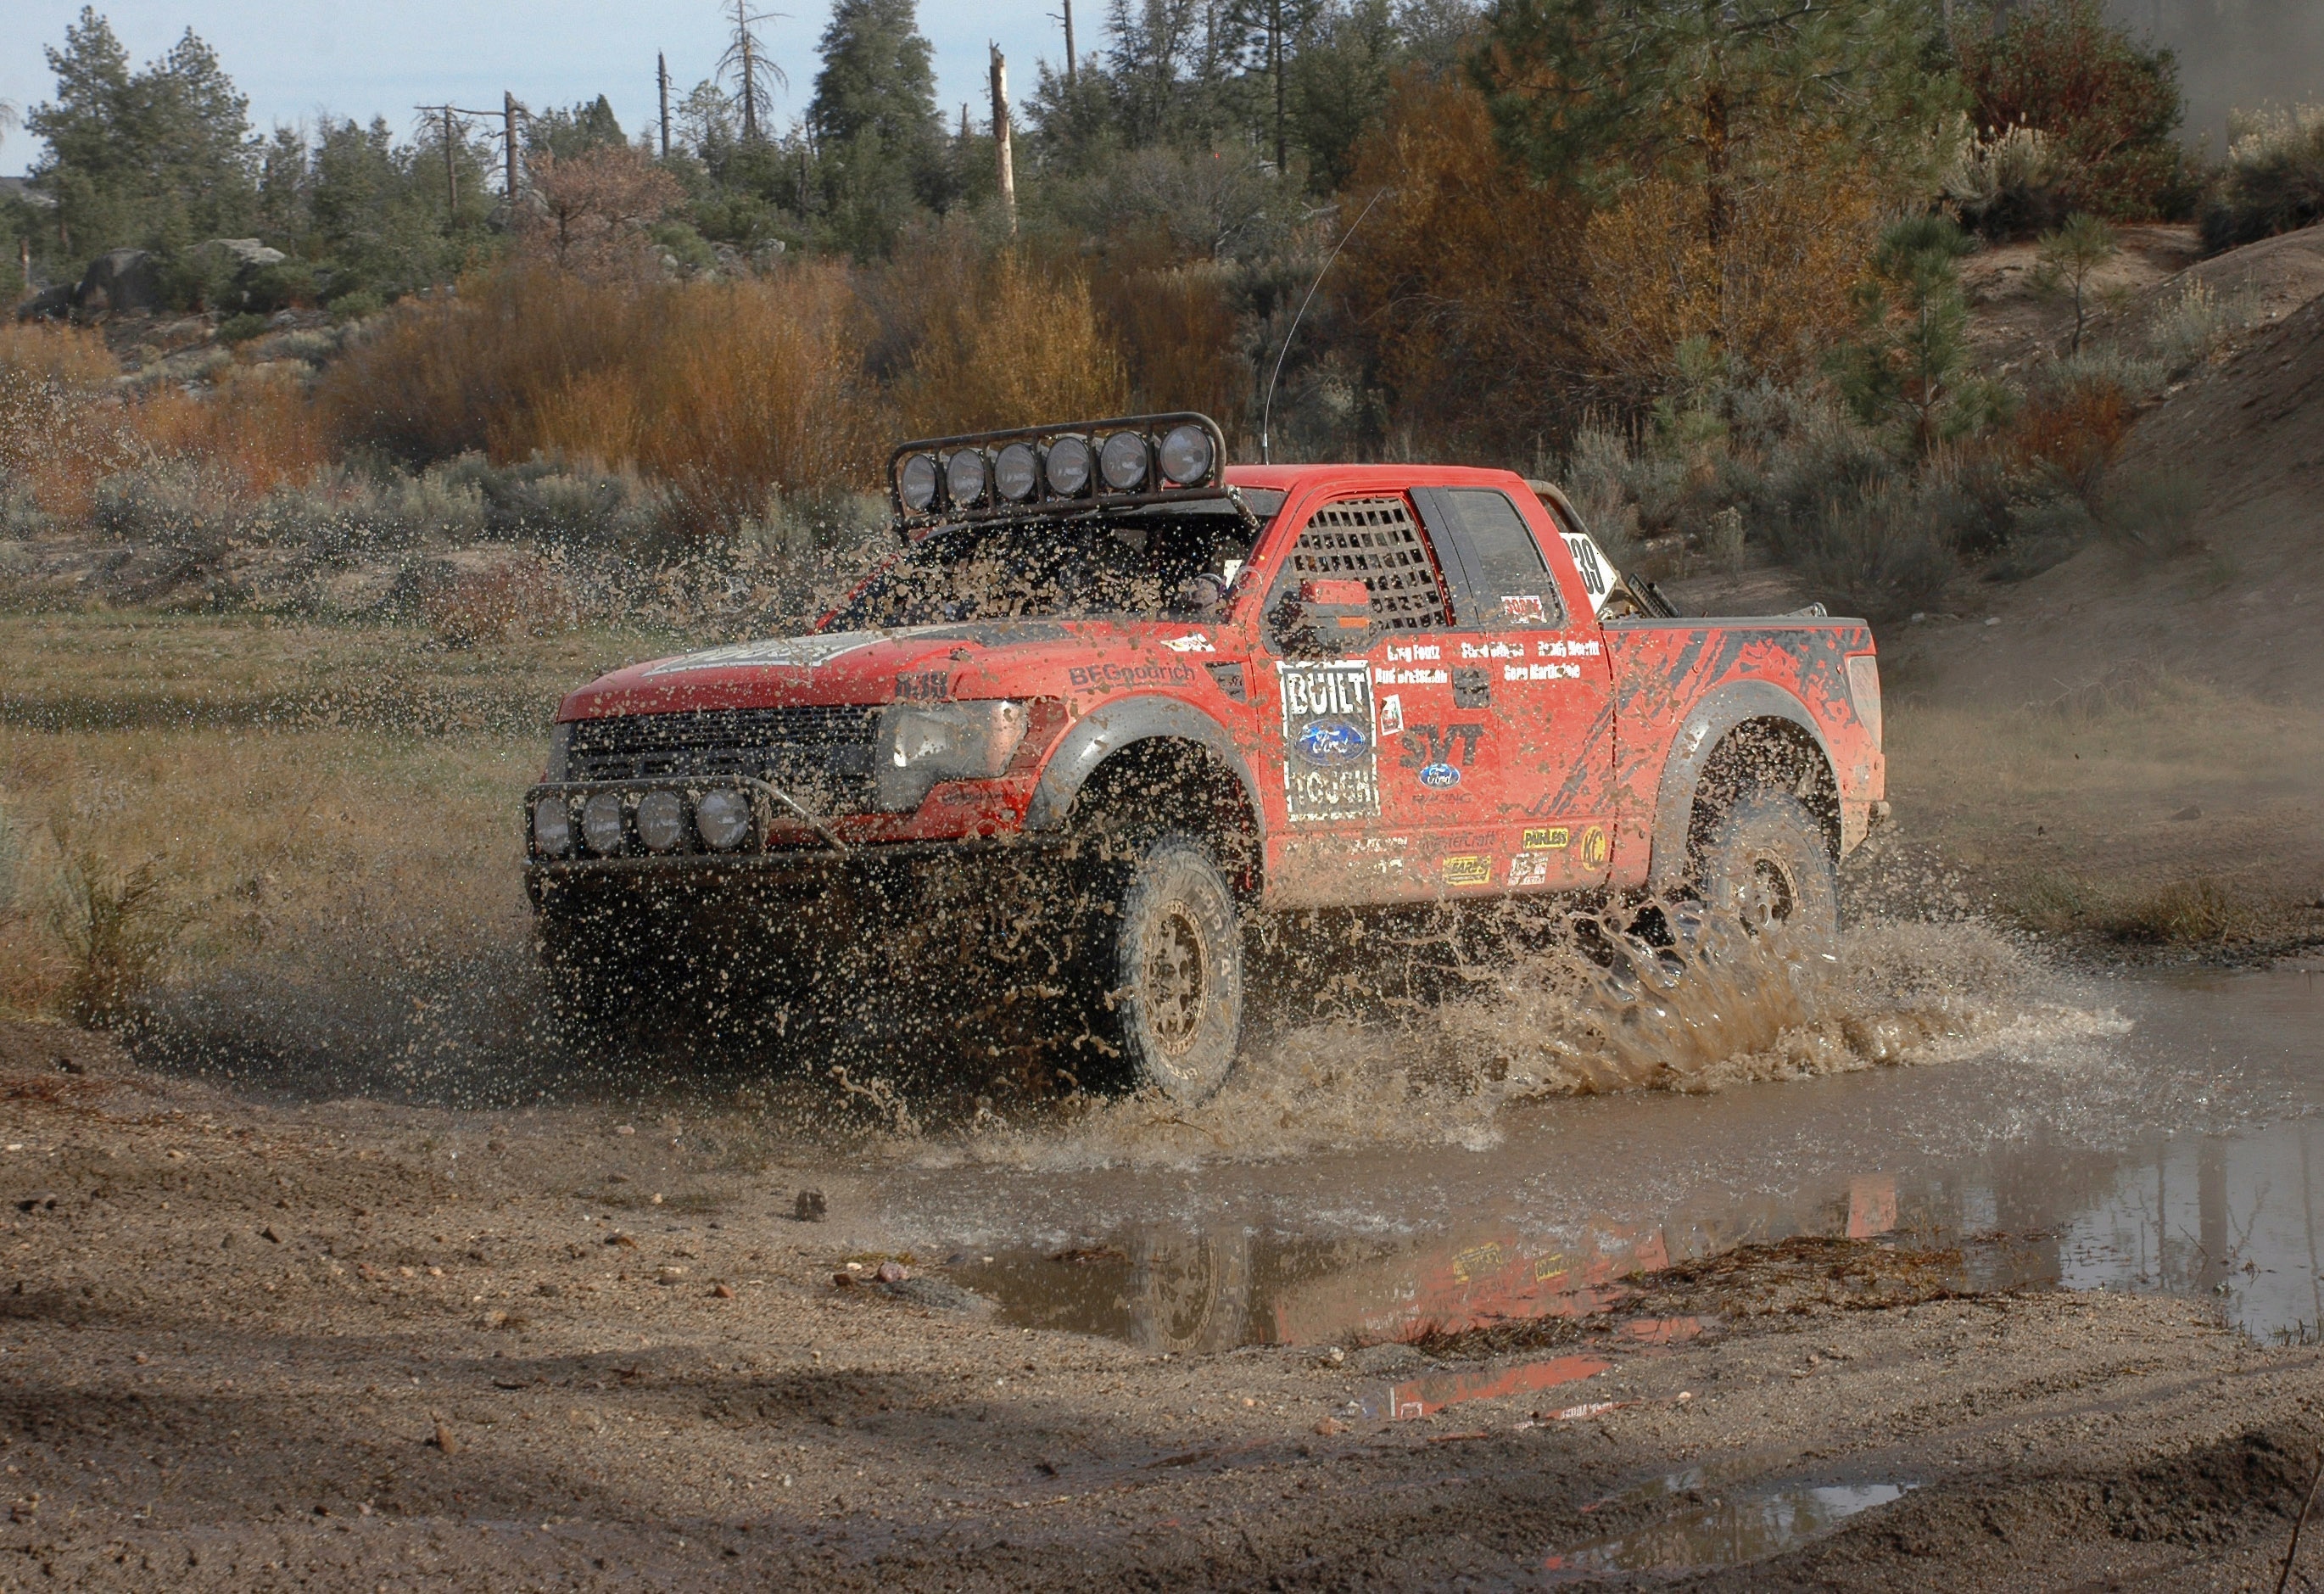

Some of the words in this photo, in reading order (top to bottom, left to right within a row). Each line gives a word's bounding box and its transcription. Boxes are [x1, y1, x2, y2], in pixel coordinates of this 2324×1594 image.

[1561, 538, 1606, 595] 39
[1069, 662, 1196, 686] BFGoodrich
[1287, 673, 1366, 715] BUILT
[1312, 729, 1349, 754] Ford
[1399, 724, 1484, 769] SVT
[1427, 763, 1453, 785] Ford
